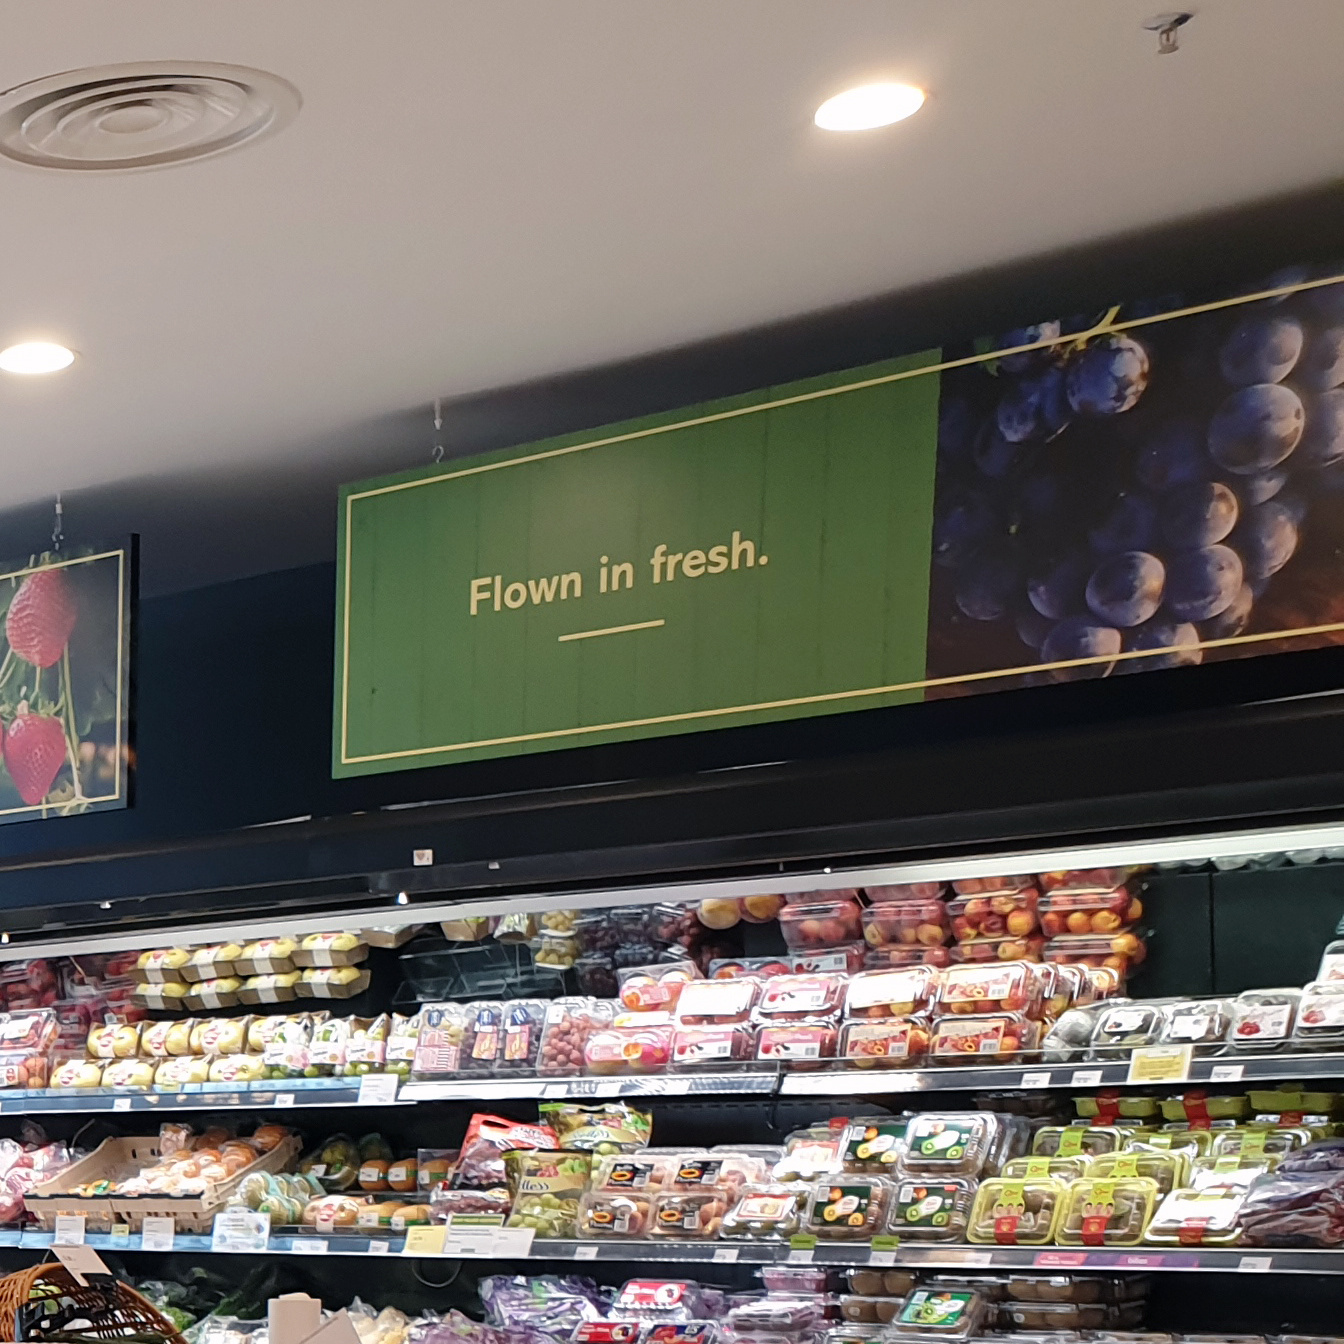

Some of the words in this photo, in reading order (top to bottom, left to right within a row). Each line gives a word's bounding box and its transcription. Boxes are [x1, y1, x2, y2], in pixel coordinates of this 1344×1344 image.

[469, 571, 583, 616] Flown
[598, 555, 634, 594] in
[650, 530, 769, 584] fresh.
